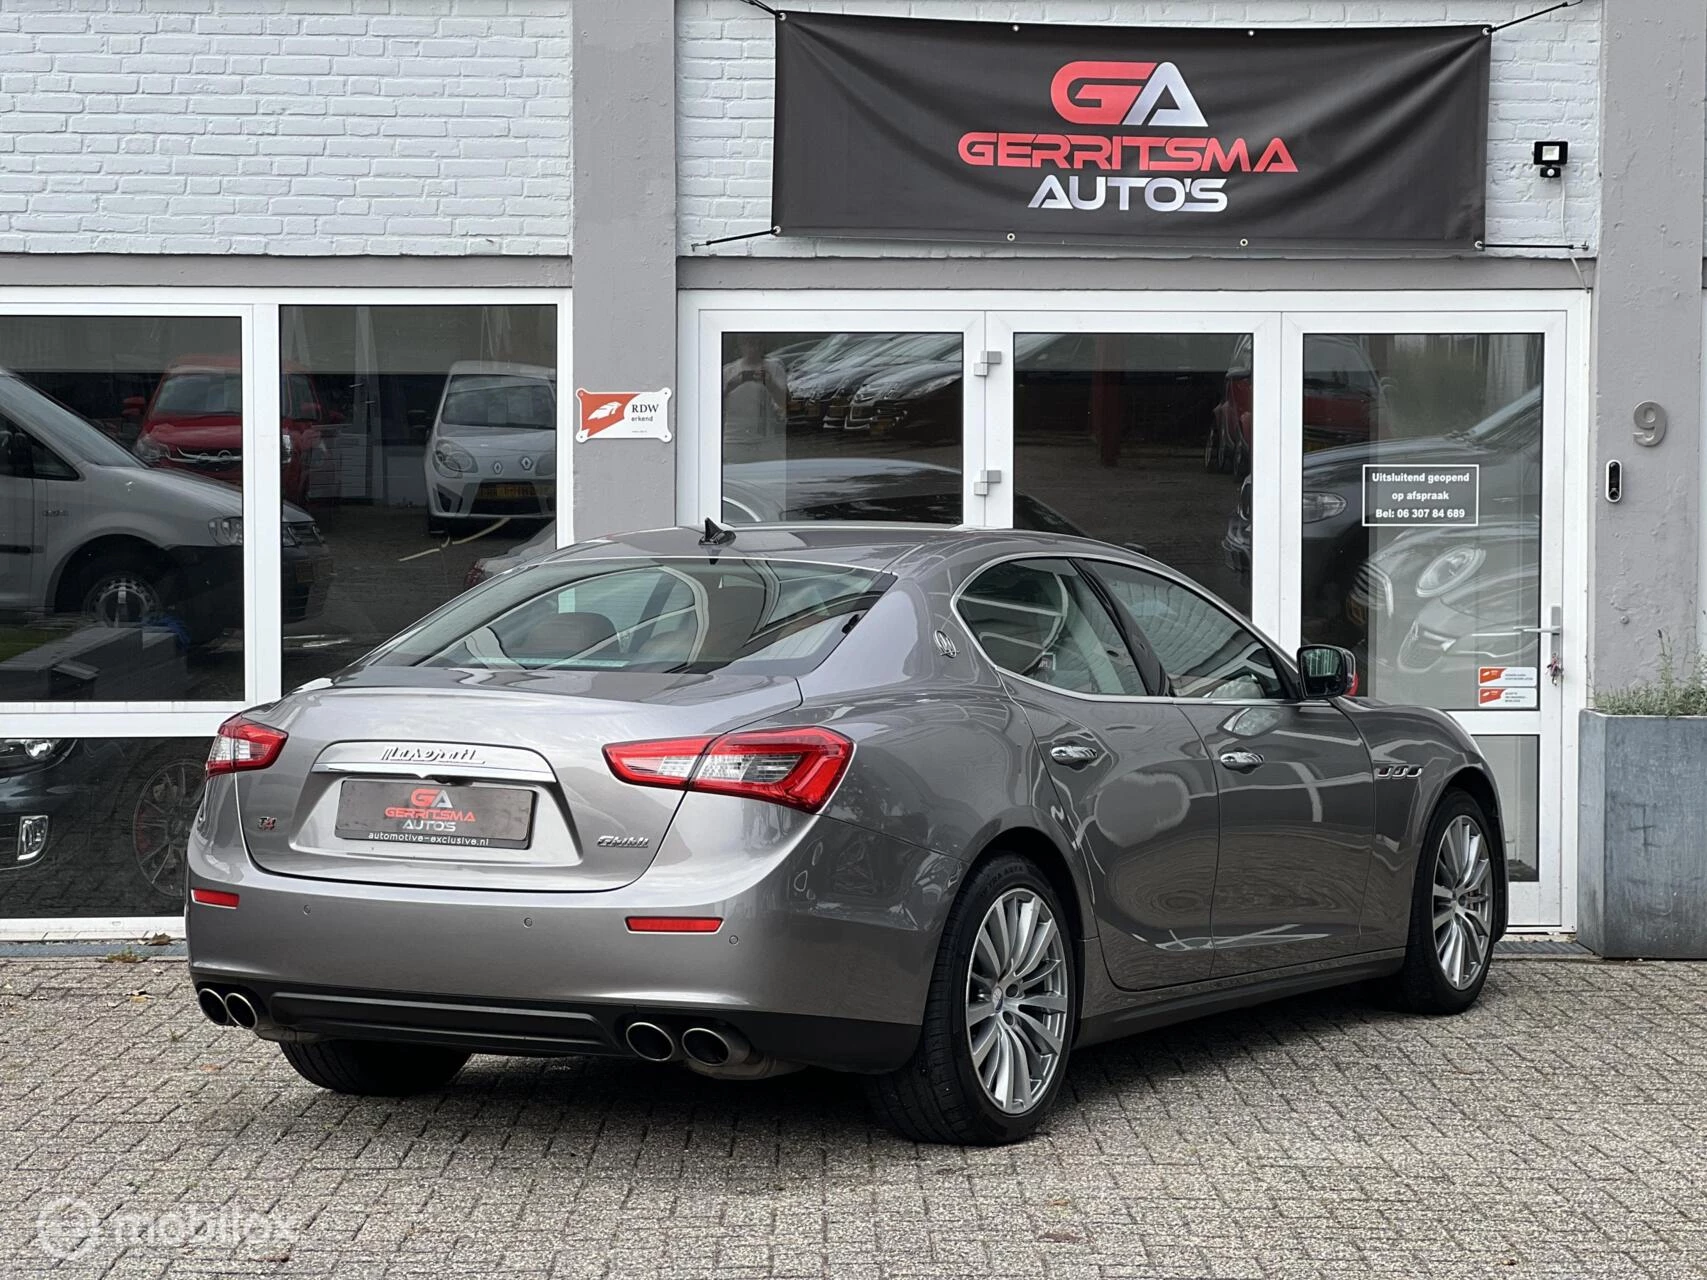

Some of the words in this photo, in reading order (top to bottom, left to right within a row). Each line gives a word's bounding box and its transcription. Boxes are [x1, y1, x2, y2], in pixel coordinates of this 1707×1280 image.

[1050, 61, 1209, 127] GA
[958, 132, 1299, 173] GERRITSMA
[1027, 174, 1228, 212] AUTO'S
[631, 404, 659, 413] RDW
[1632, 400, 1667, 448] 9
[1372, 472, 1425, 482] Uitsluitend
[1428, 473, 1470, 484] geopend
[1392, 493, 1404, 502] op
[1406, 491, 1449, 502] afspraak
[1375, 508, 1395, 518] Bel:
[1397, 508, 1409, 518] 06
[1412, 508, 1429, 518] 307
[1432, 508, 1445, 518] 84
[1447, 508, 1465, 518] 689
[411, 788, 453, 809] GA
[384, 806, 476, 822] GERRITSMA
[402, 819, 456, 832] AUTO'S
[368, 831, 489, 846] automotive-exclusive.nl
